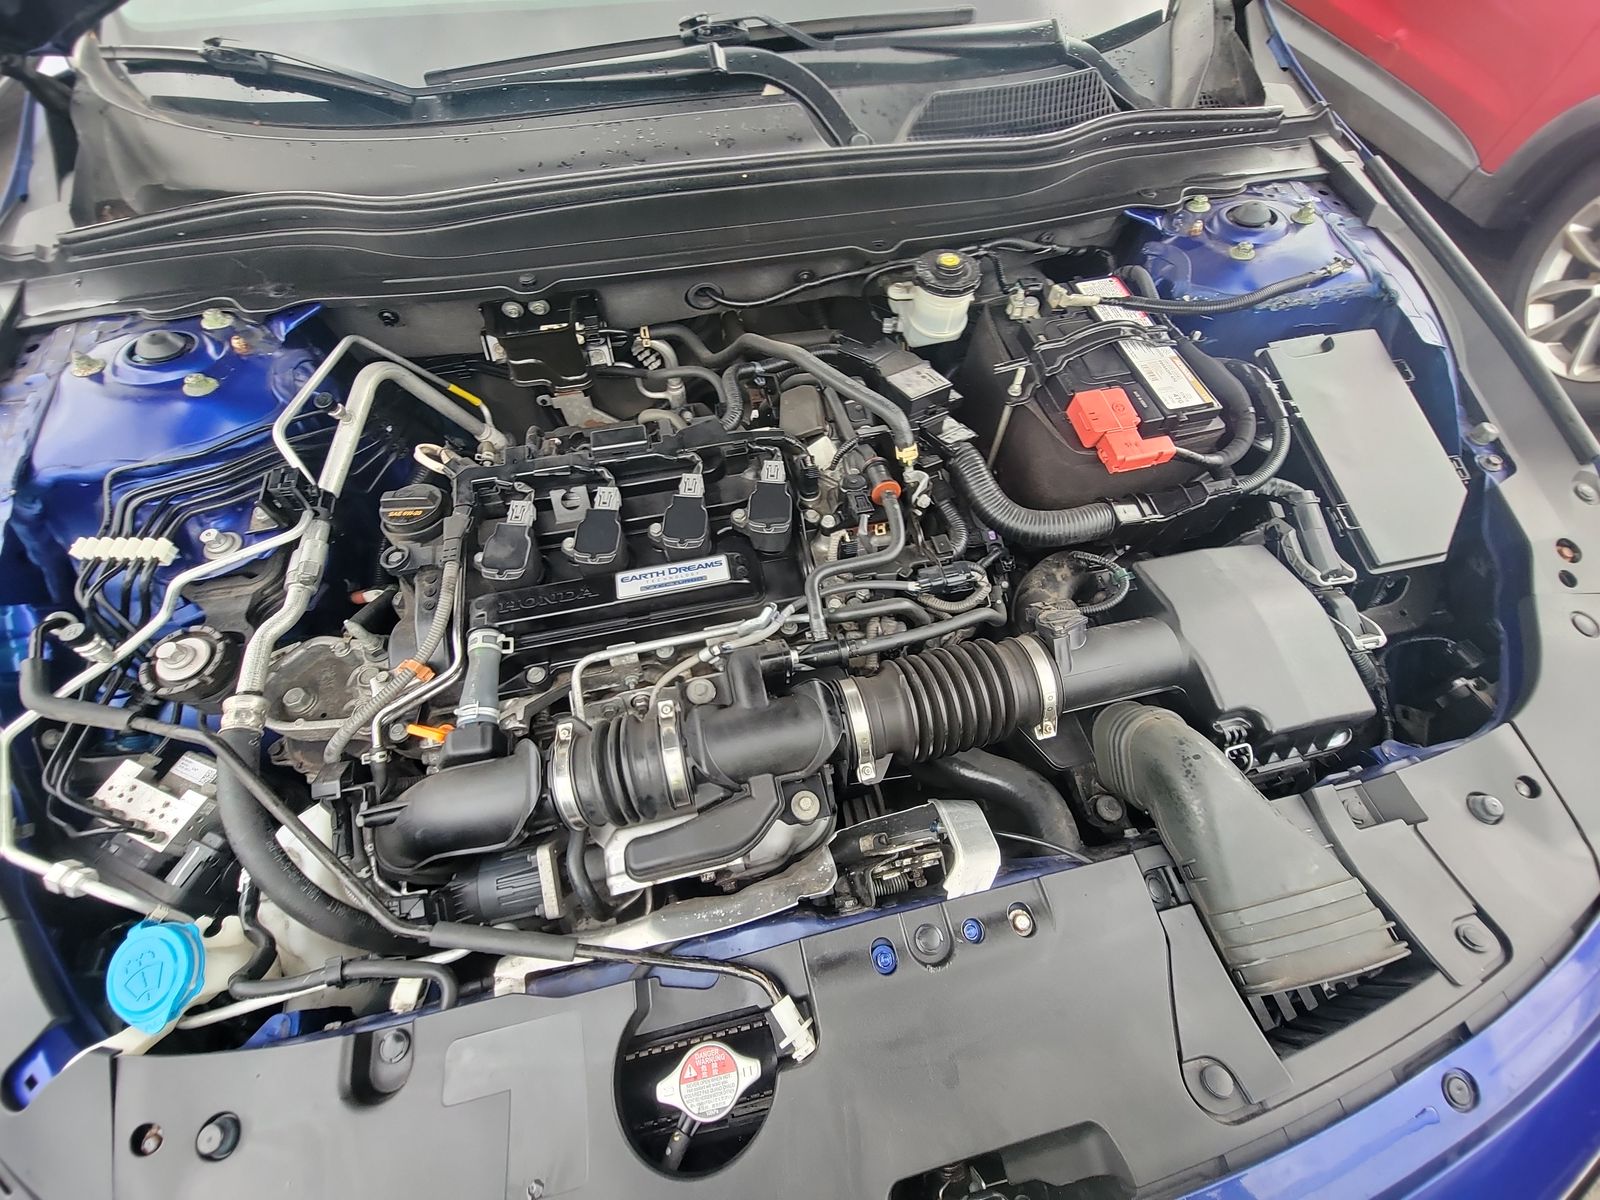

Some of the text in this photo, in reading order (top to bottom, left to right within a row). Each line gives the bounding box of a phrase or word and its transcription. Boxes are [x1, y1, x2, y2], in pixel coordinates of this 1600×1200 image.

[620, 560, 723, 583] EARTH DREAMS
[498, 586, 600, 613] HONDA
[695, 1049, 719, 1059] DANGER
[696, 1054, 725, 1066] WARNING
